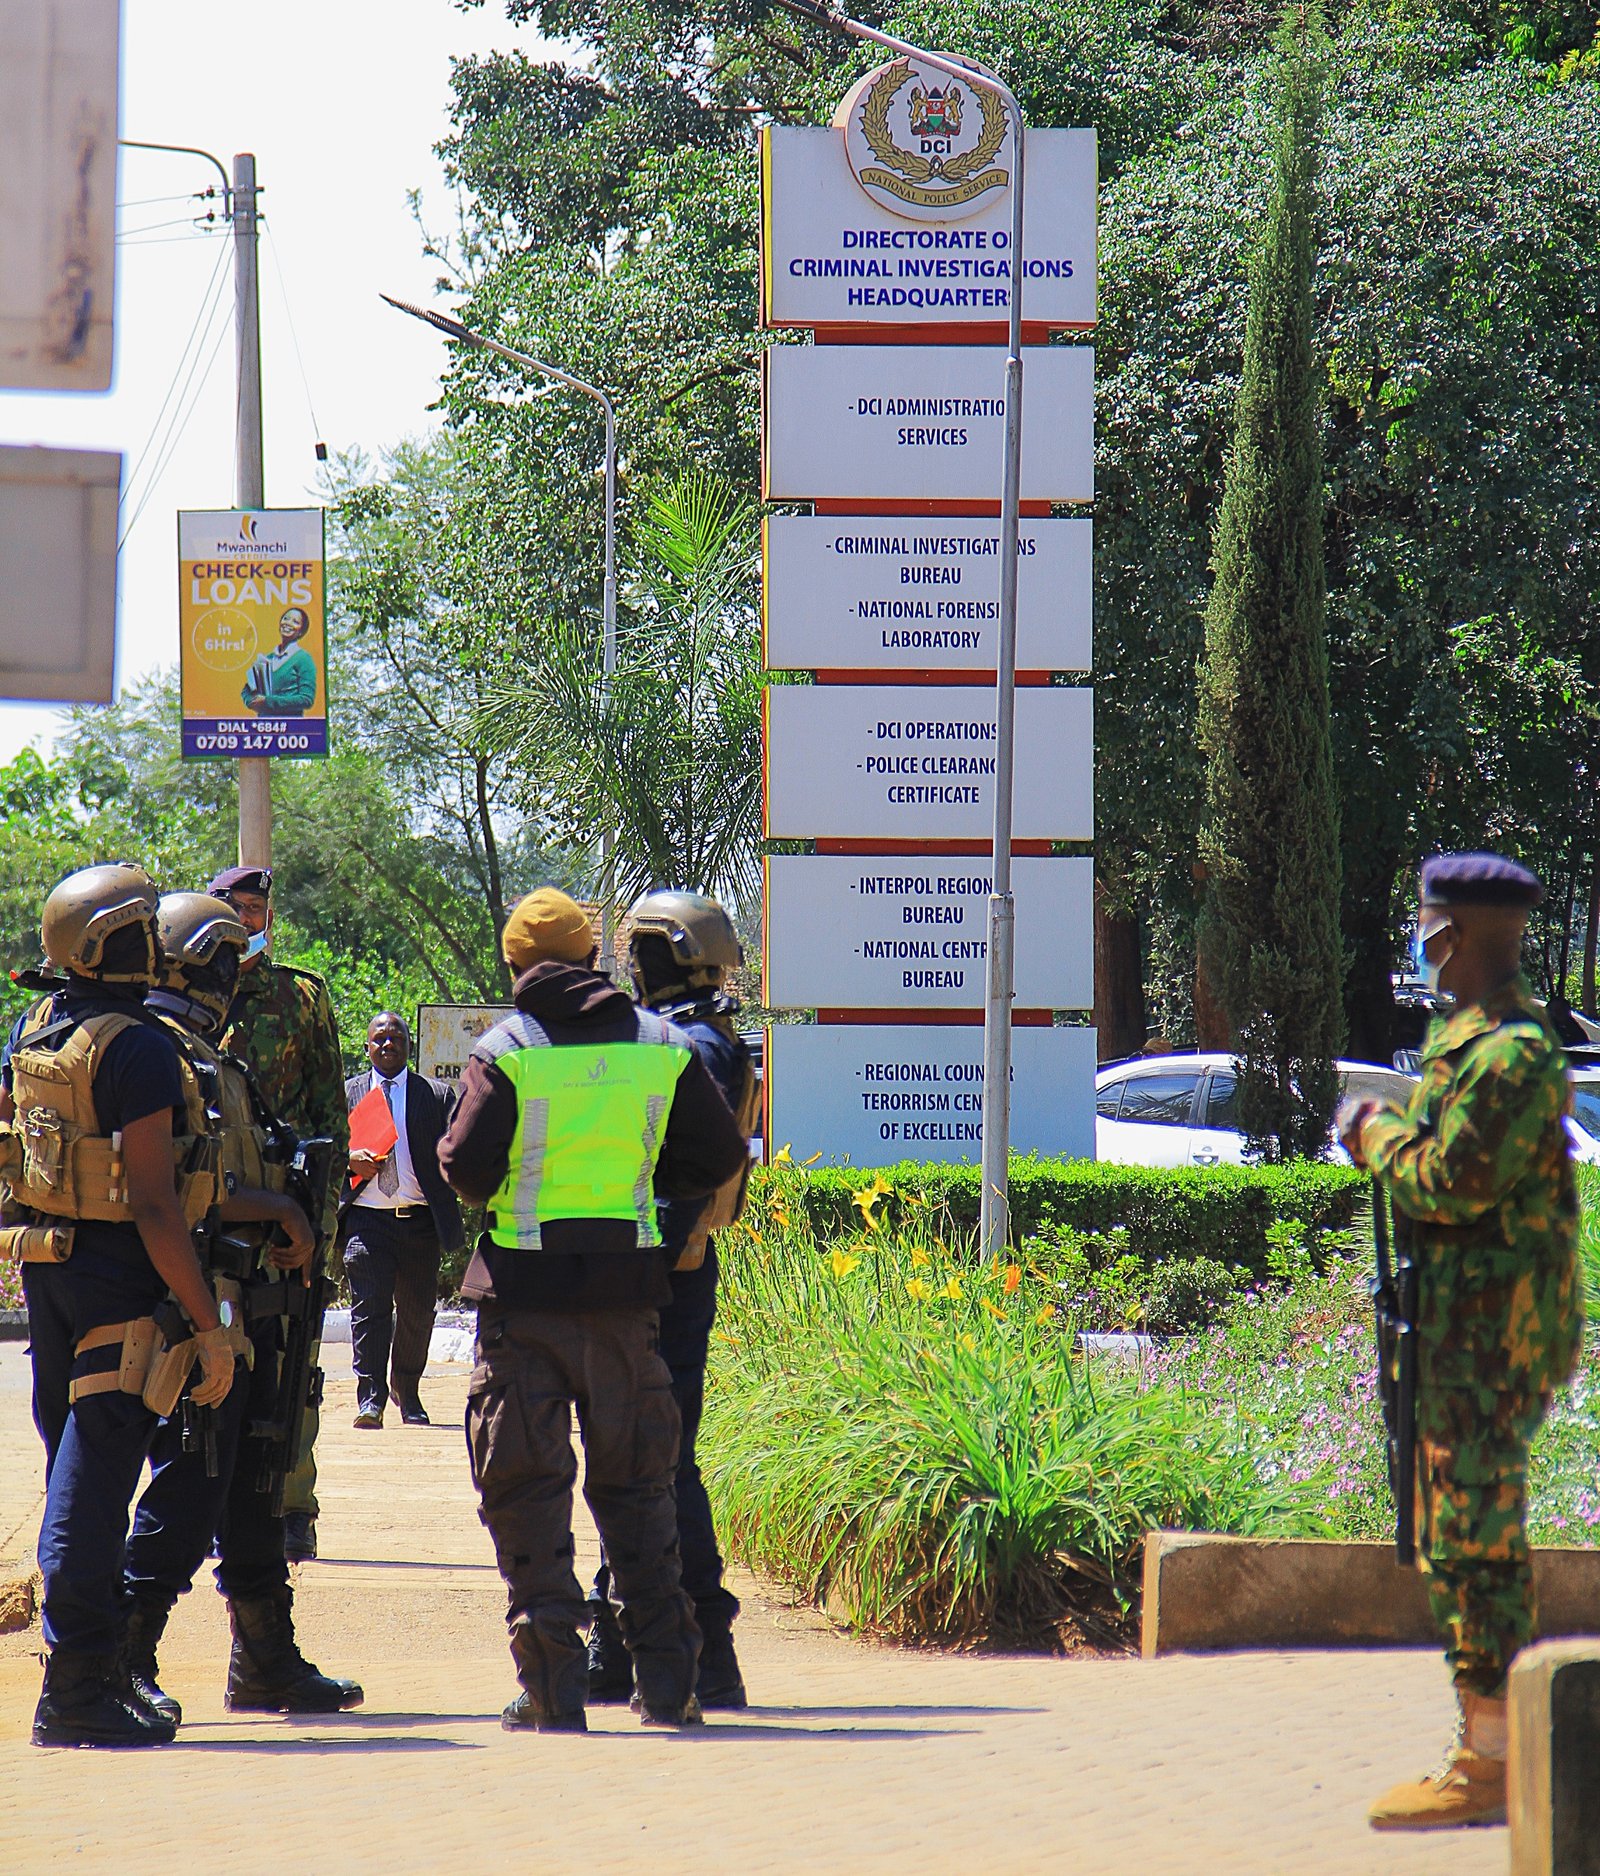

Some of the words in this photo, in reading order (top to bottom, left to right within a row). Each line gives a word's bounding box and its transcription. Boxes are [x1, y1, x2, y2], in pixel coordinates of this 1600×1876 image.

[920, 140, 951, 153] DCI
[868, 172, 917, 201] NATIONAL
[923, 193, 959, 204] POLICE
[963, 173, 1002, 197] SERVICE
[843, 231, 987, 249] DIRECTORATE
[992, 231, 1011, 249] O
[789, 259, 893, 278] CRIMINAL
[899, 259, 1074, 278] INVESTIGAIONS
[848, 288, 1010, 308] HEADQUARTER
[858, 398, 882, 416] DCI
[886, 399, 1005, 417] ADMINISTRATIO
[898, 428, 968, 446] SERVICES
[217, 542, 287, 553] Mwananchi
[835, 537, 910, 555] CRIMINAL
[914, 538, 1036, 556] INVESTIGATNS
[192, 563, 313, 579] CHECK-OFF
[900, 567, 961, 585] BUREAU
[191, 579, 313, 605] LOANS
[858, 601, 934, 619] NATIONAL
[938, 602, 1000, 620] FORENSI
[217, 623, 232, 635] in
[205, 638, 245, 651] 6Hrs!
[882, 630, 981, 649] LABORATORY
[217, 722, 249, 733] DIAL
[877, 722, 902, 739] DCI
[196, 736, 238, 749] 0709
[243, 736, 273, 749] 147
[277, 736, 309, 749] 000
[866, 756, 919, 774] POLICE
[921, 757, 996, 775] CLEARANC
[888, 786, 980, 804] CERTIFICATE
[860, 877, 934, 895] INTERPOL
[937, 877, 993, 895] REGION
[902, 907, 964, 924] BUREAU
[863, 941, 939, 959] NATIONAL
[942, 941, 988, 959] CENTR
[902, 970, 964, 988] BUREAU
[865, 1064, 941, 1082] REGIONAL
[944, 1064, 1014, 1082] COUN
[861, 1093, 950, 1111] TERORRISM
[879, 1123, 899, 1140] OF
[903, 1123, 983, 1141] EXCELLENC
